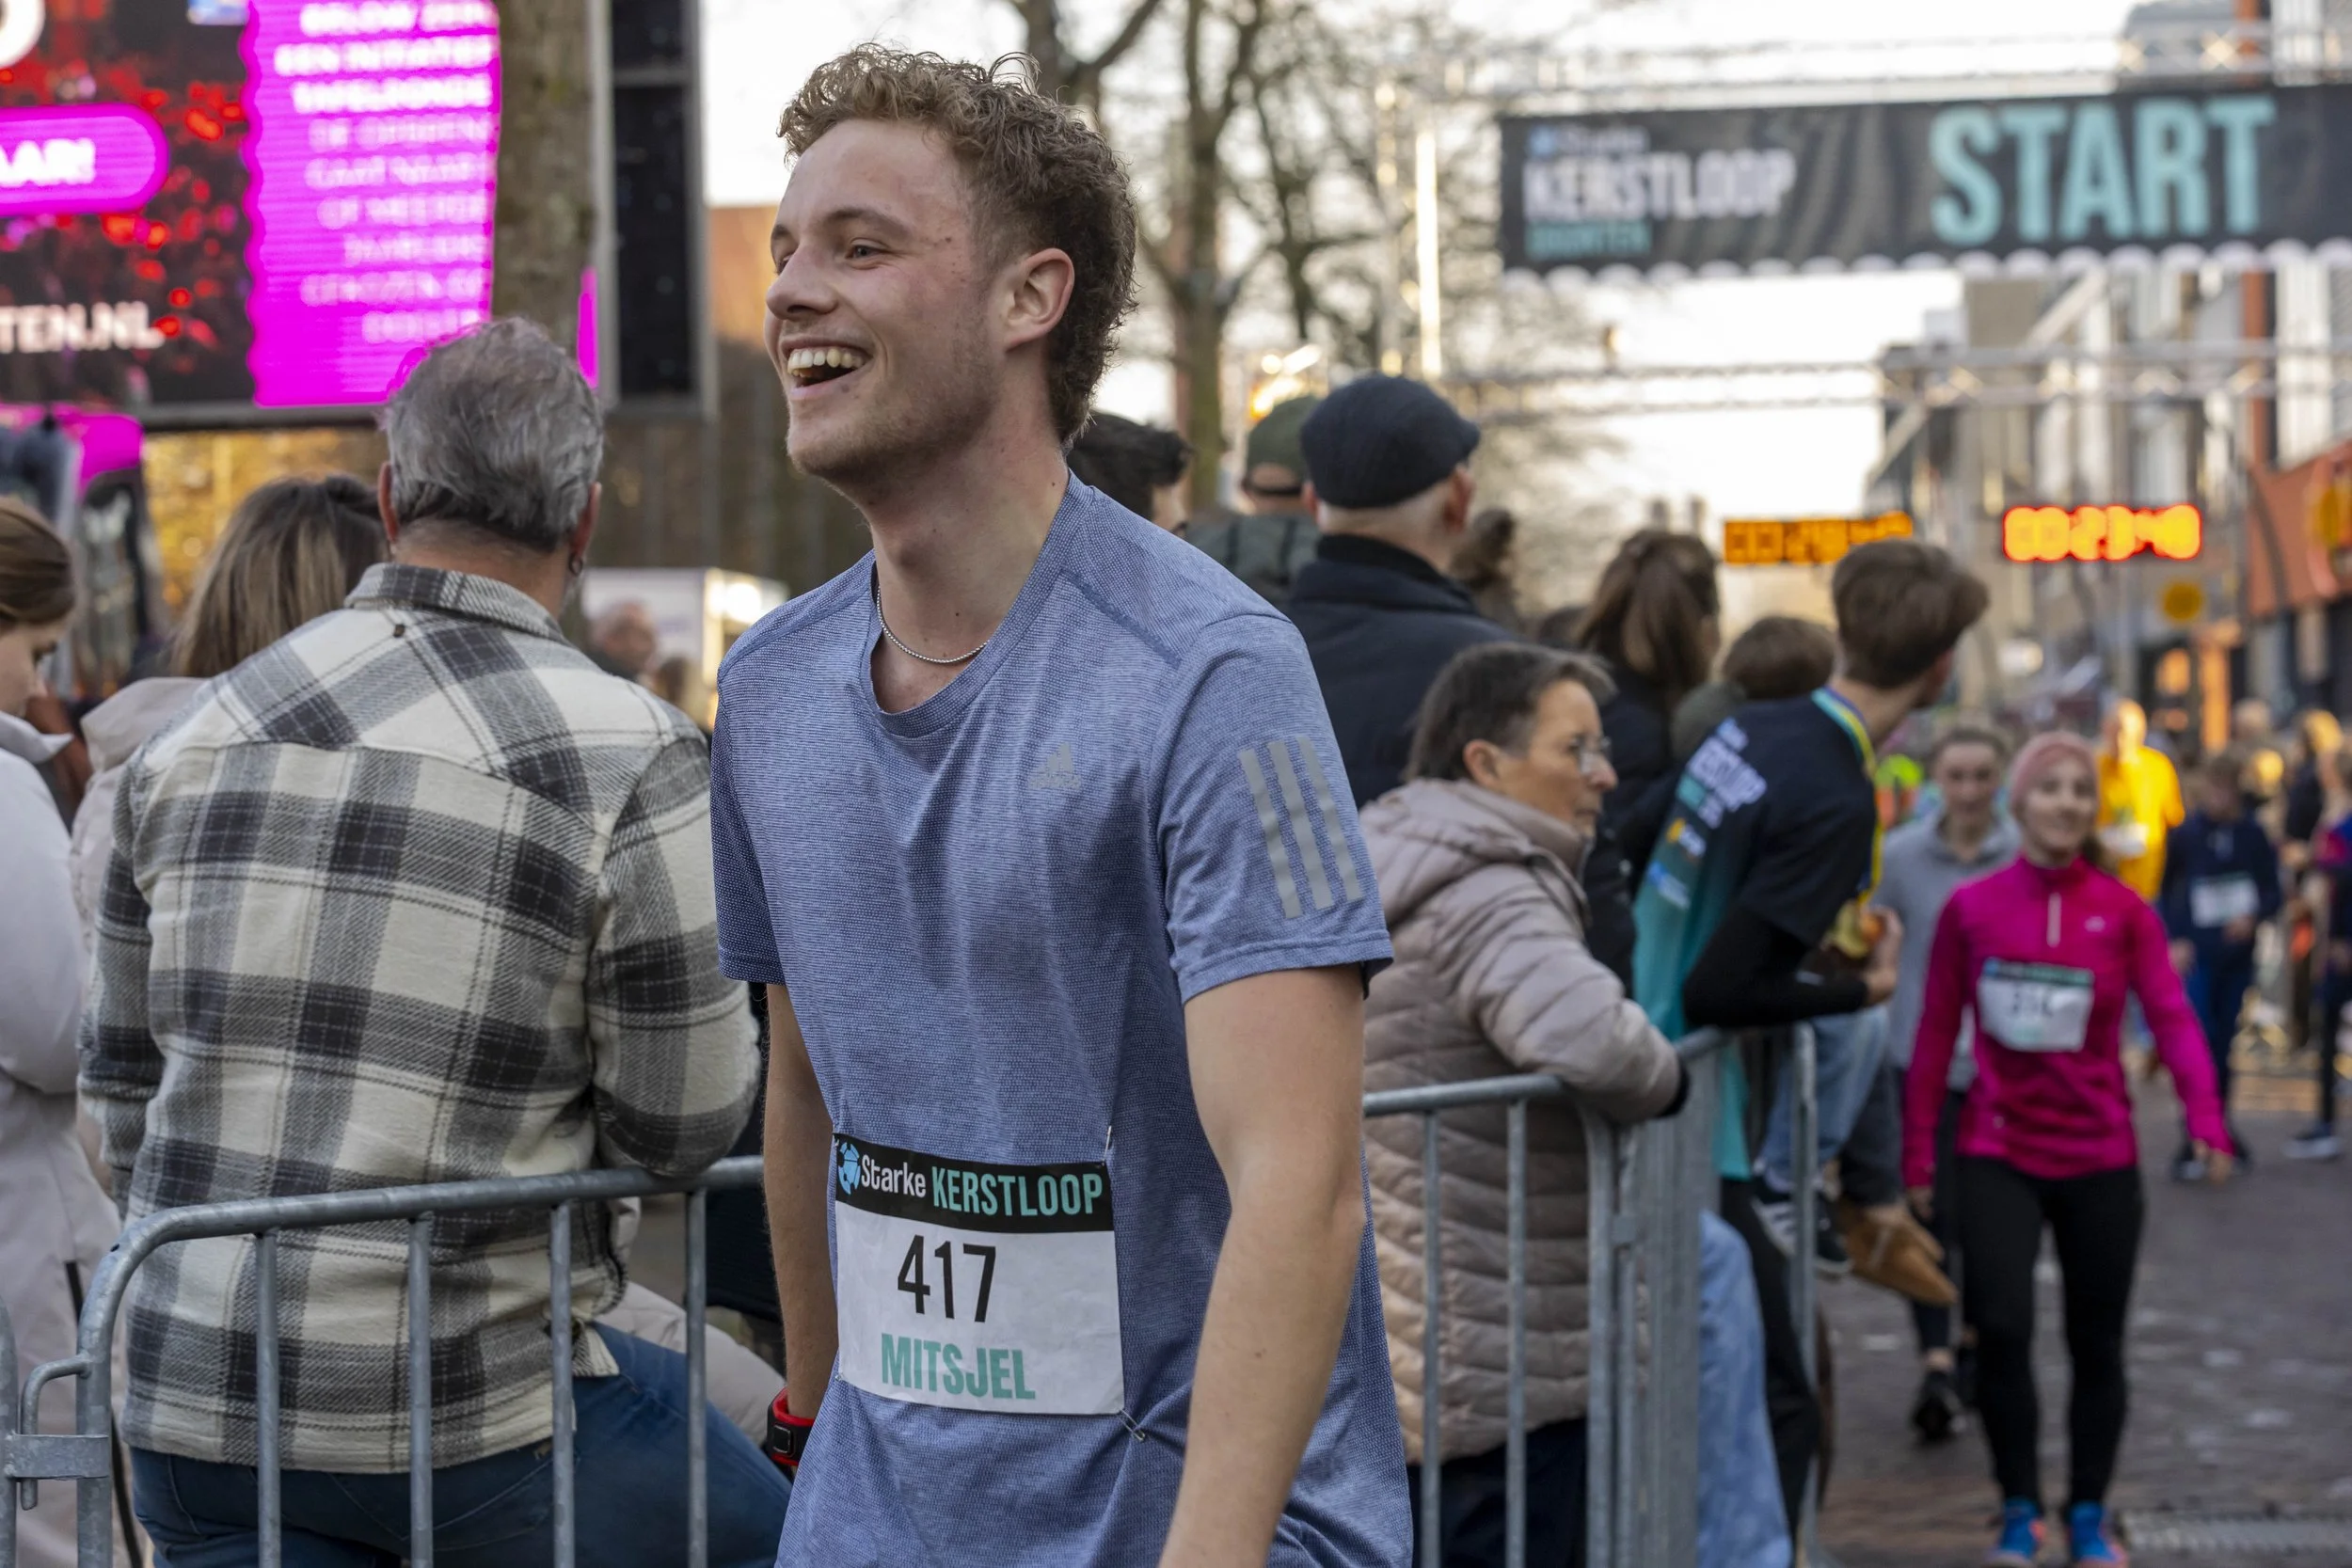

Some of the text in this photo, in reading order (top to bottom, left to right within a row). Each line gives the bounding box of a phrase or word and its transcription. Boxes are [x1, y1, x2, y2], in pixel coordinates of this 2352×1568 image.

[1522, 148, 1796, 222] KERSTLOOP
[1931, 95, 2276, 246] START
[860, 1153, 1103, 1216] Starke KERSTLOOP
[897, 1234, 997, 1323] 417
[881, 1332, 1036, 1401] MITSJEL
